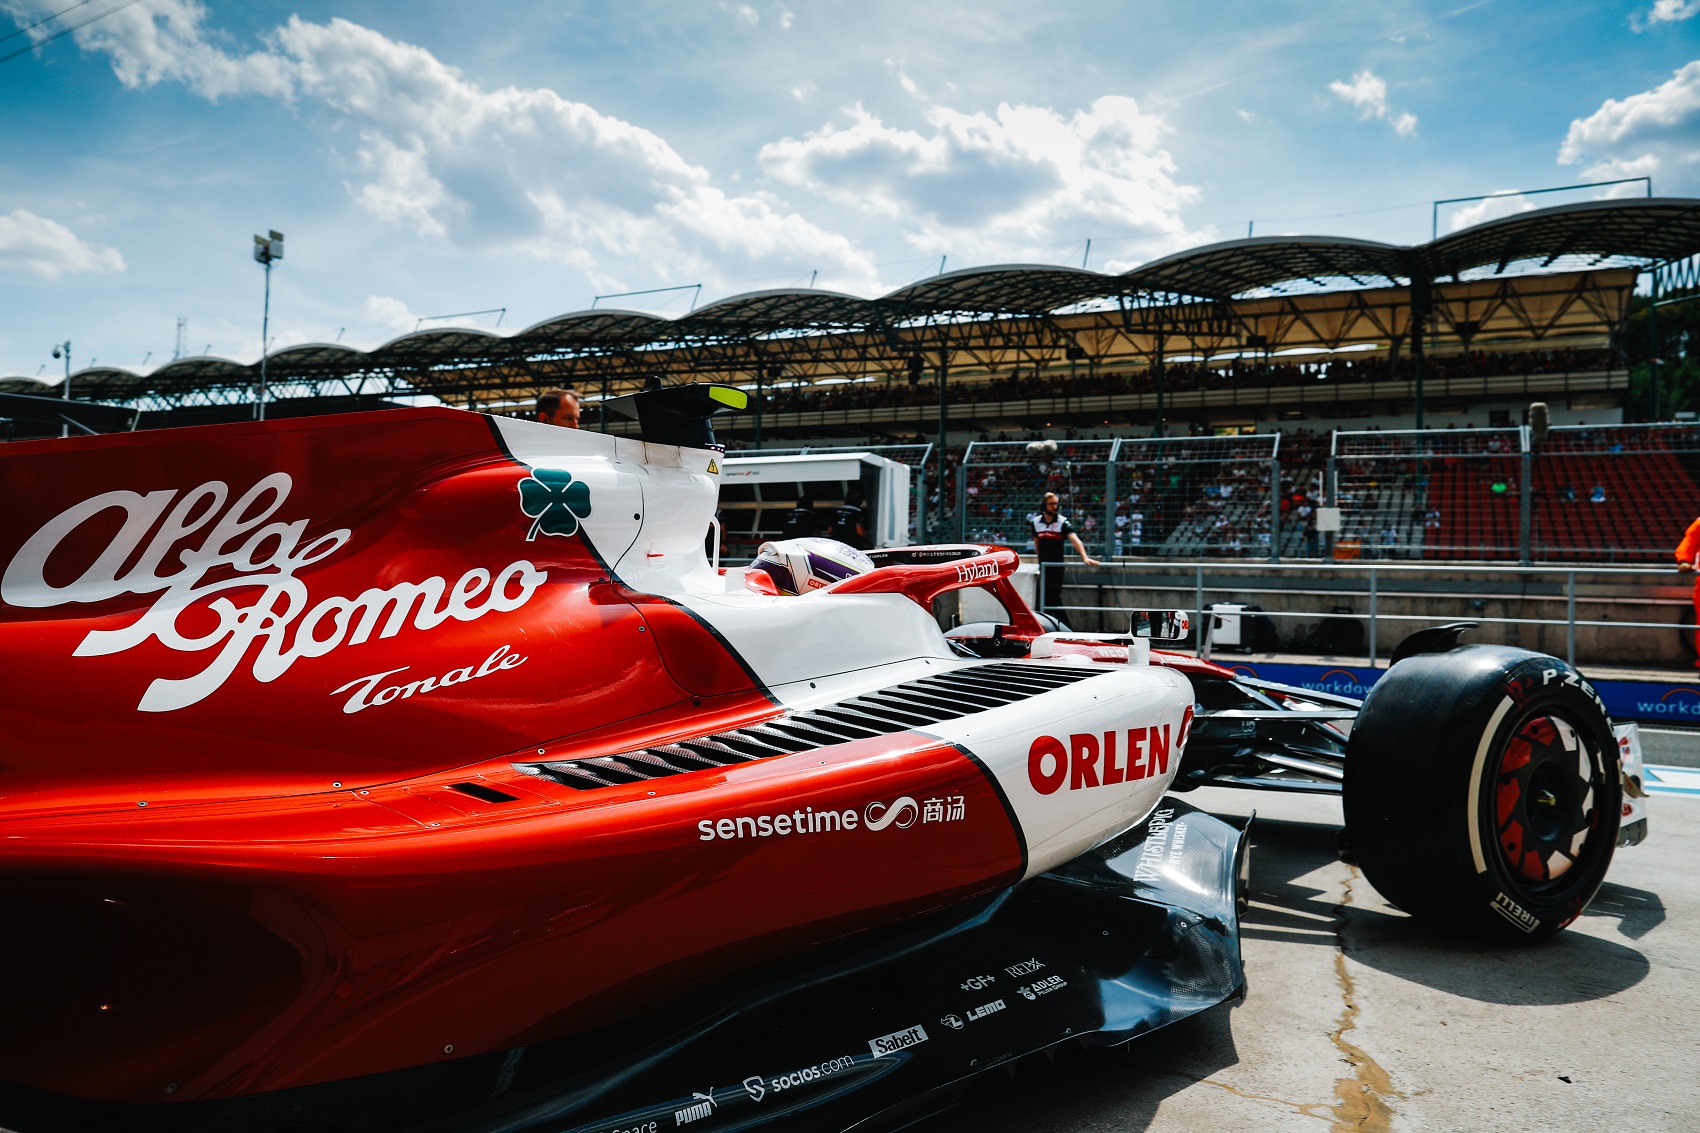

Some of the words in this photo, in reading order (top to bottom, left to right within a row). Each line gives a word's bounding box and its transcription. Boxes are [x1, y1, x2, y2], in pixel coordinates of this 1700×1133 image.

[955, 559, 999, 584] Hyland
[137, 559, 547, 712] Romeo
[330, 644, 528, 713] Tonale
[1028, 724, 1170, 795] ORLEN
[698, 806, 859, 841] sensetime
[923, 796, 965, 824] 商汤
[1490, 891, 1540, 933] PIRELLI
[1030, 975, 1064, 992] ADLER
[966, 999, 1006, 1021] LEMO
[875, 1028, 922, 1055] Sabelt
[771, 1055, 855, 1093] socios.com
[674, 1101, 712, 1126] PUMA
